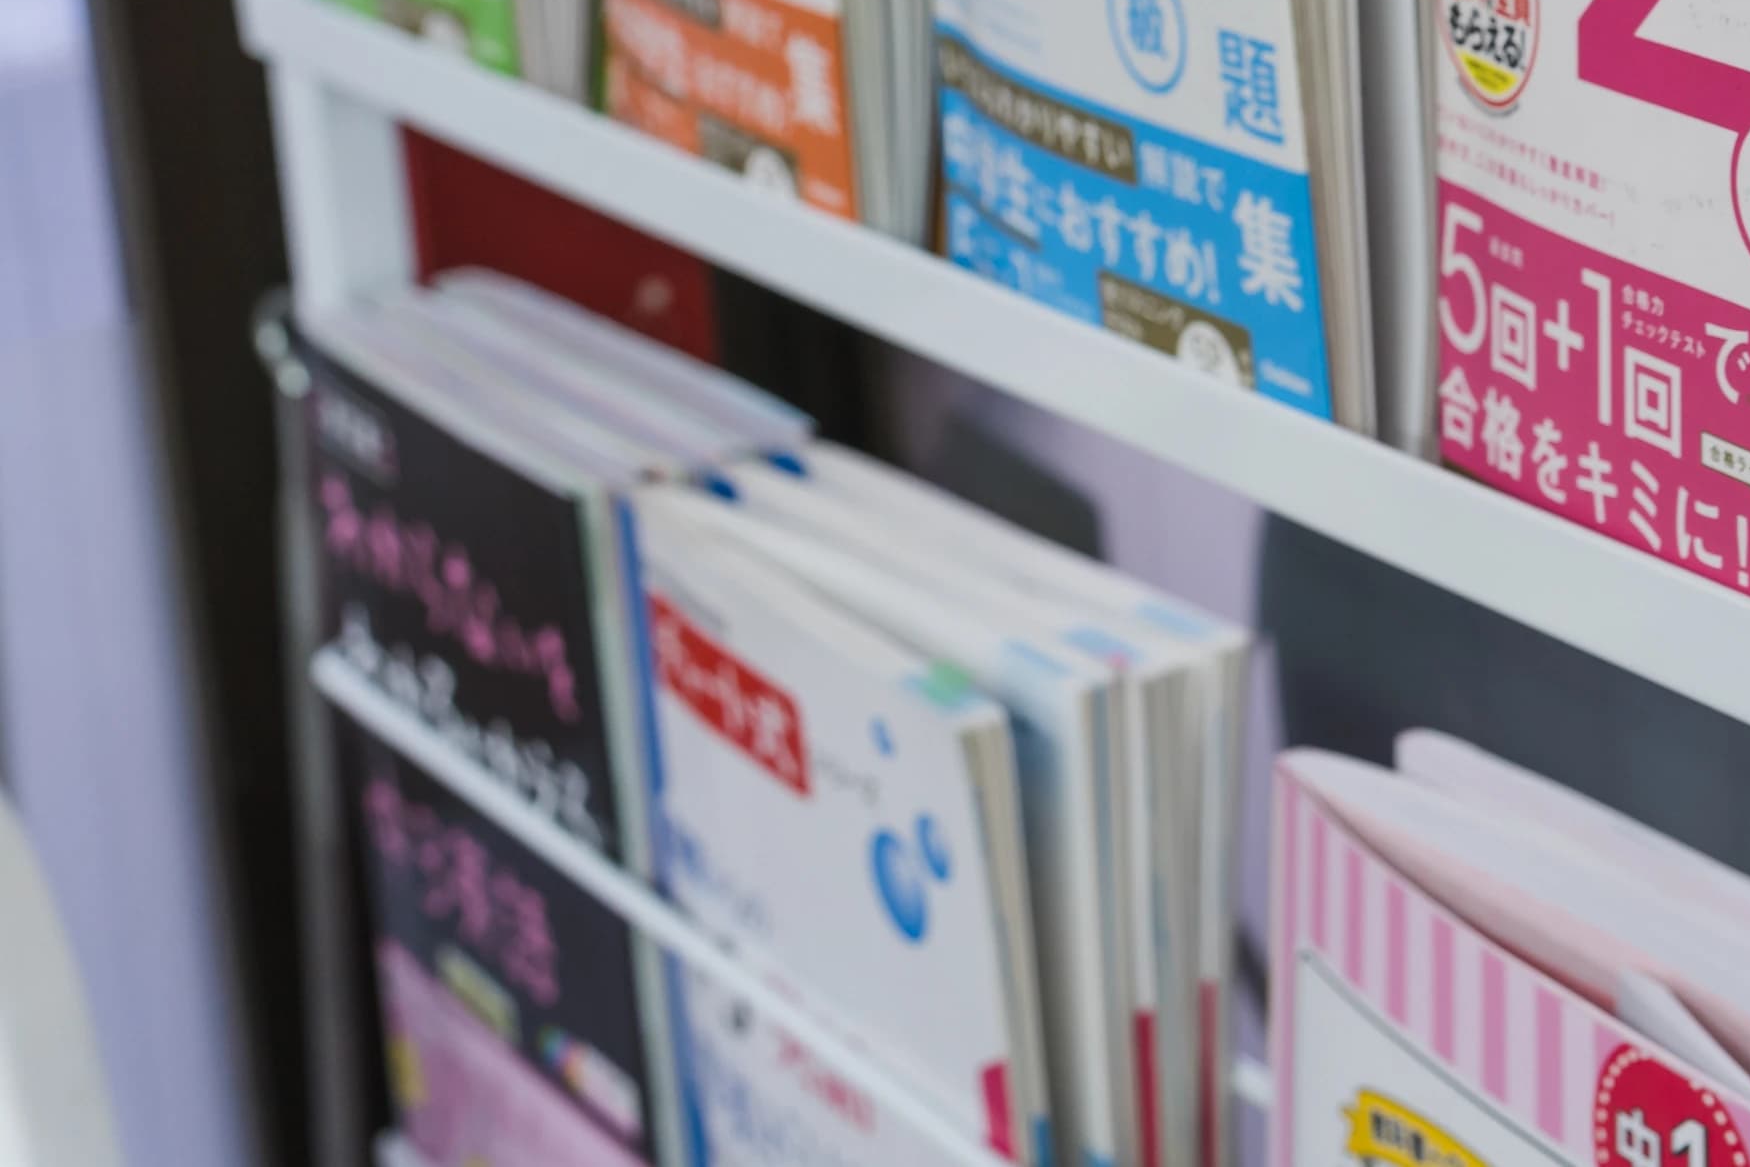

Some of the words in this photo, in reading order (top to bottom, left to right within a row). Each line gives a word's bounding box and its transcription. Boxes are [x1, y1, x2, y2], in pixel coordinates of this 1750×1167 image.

[1439, 368, 1750, 588] 合格をキミに!
